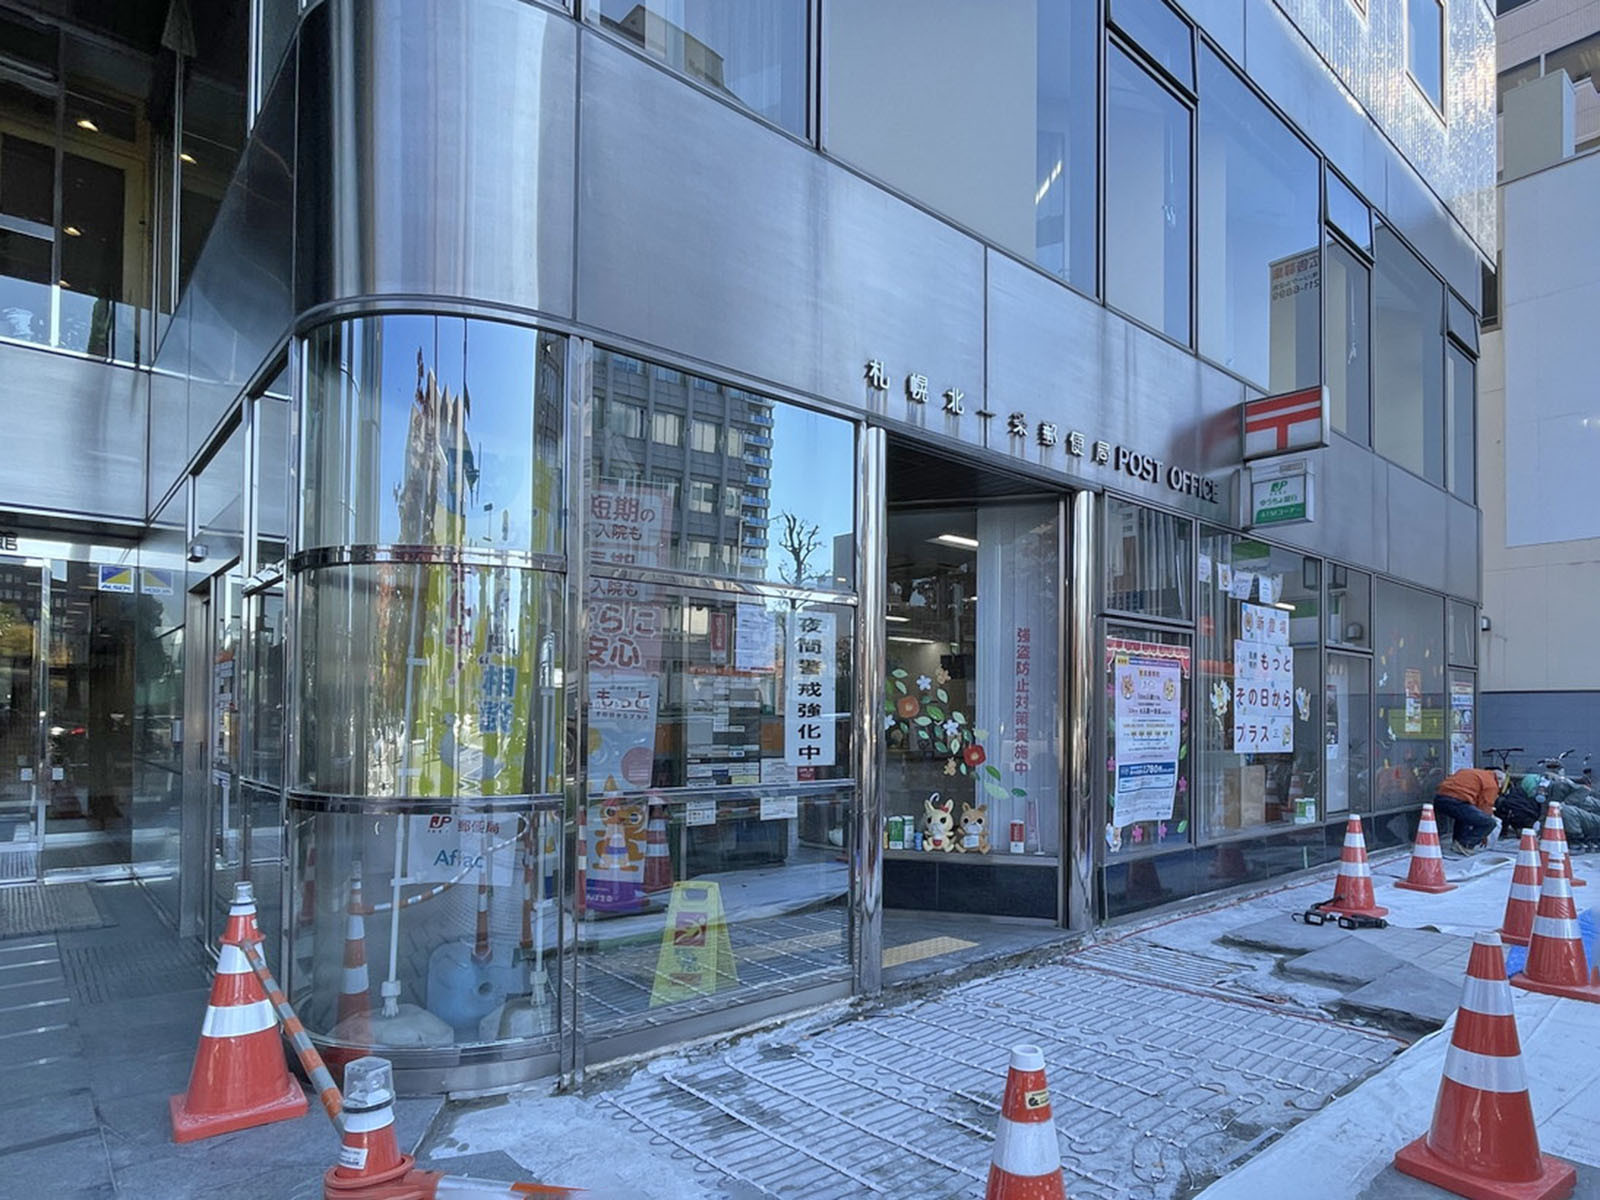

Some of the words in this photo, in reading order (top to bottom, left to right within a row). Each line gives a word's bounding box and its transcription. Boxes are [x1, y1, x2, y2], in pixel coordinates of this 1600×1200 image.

[1114, 446, 1164, 483] POST
[1167, 466, 1219, 504] OFFICE
[595, 523, 643, 541] 入院も
[1260, 653, 1291, 673] もっと
[595, 688, 651, 710] もっと
[797, 616, 823, 761] 夜間警戒強化中
[1235, 688, 1292, 708] その日から
[1013, 627, 1032, 776] 強盗防止対策実施中
[1235, 724, 1270, 744] プラス
